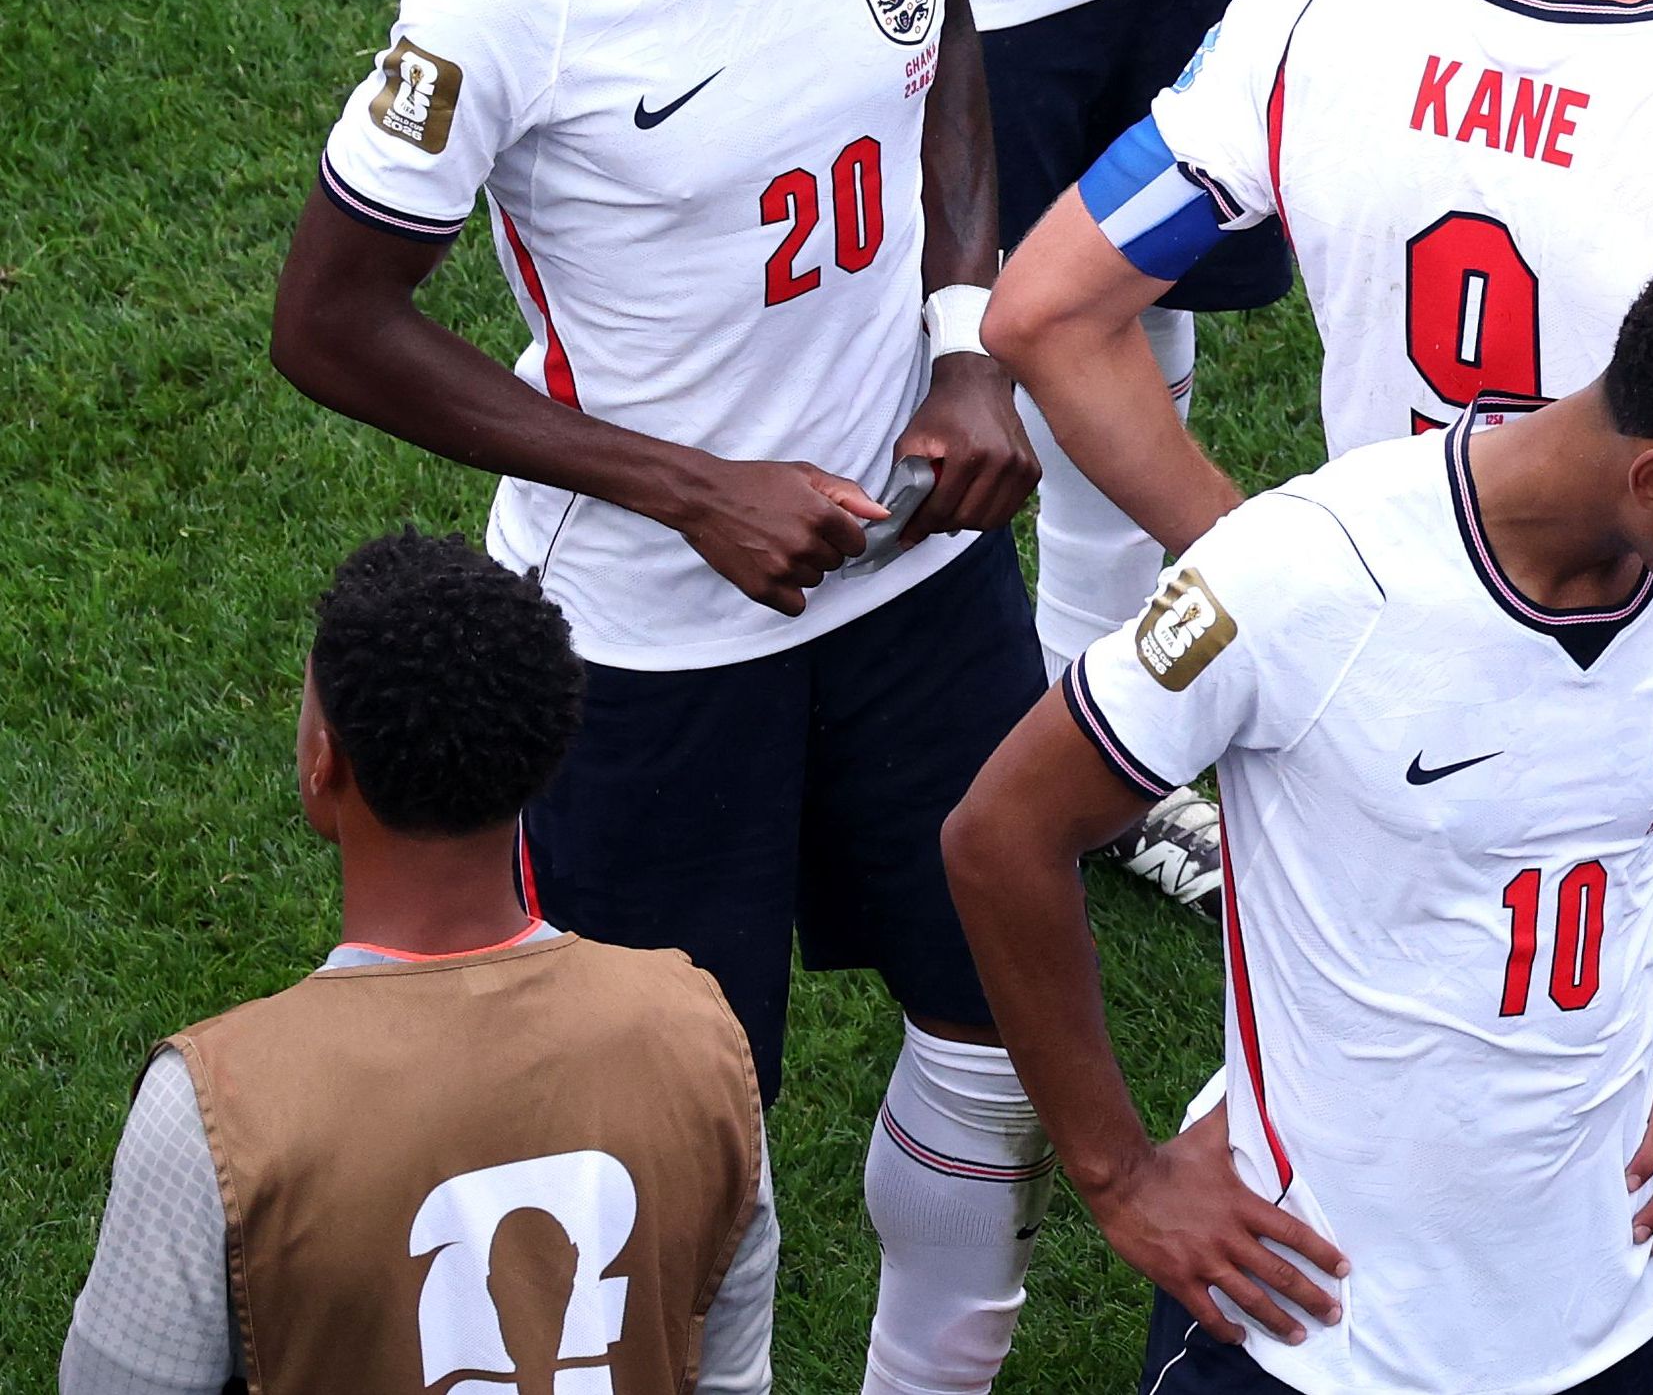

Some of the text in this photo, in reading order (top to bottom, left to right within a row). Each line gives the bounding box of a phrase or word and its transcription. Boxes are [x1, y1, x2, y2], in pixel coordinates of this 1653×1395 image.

[1409, 55, 1591, 168] KANE
[759, 134, 885, 308] 20
[1405, 210, 1543, 436] 9
[1498, 859, 1608, 1017] 10
